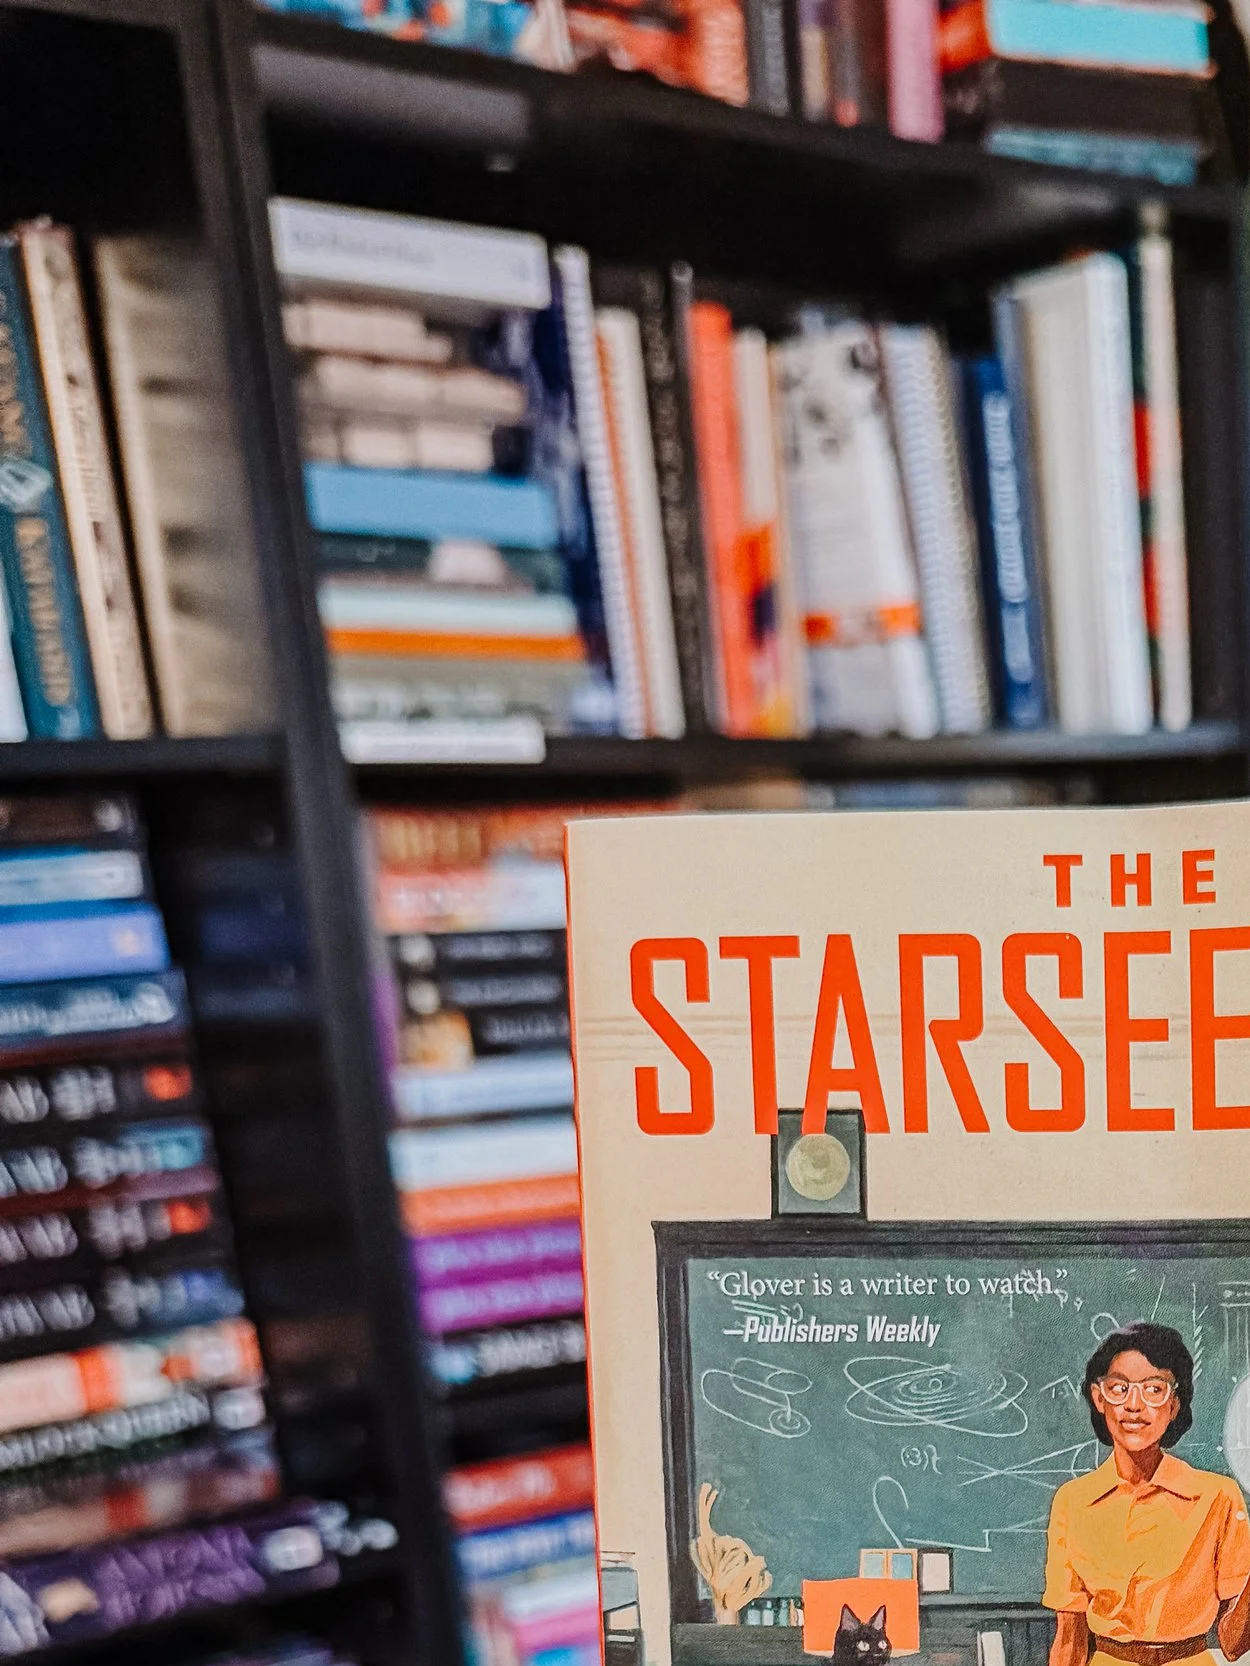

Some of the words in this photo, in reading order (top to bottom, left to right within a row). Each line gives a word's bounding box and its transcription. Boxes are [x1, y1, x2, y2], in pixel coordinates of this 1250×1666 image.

[1043, 849, 1216, 908] THE
[813, 1272, 833, 1296] is
[840, 1277, 854, 1296] a
[860, 1272, 938, 1296] writer
[944, 1274, 971, 1296] to
[866, 1315, 942, 1348] Weekly
